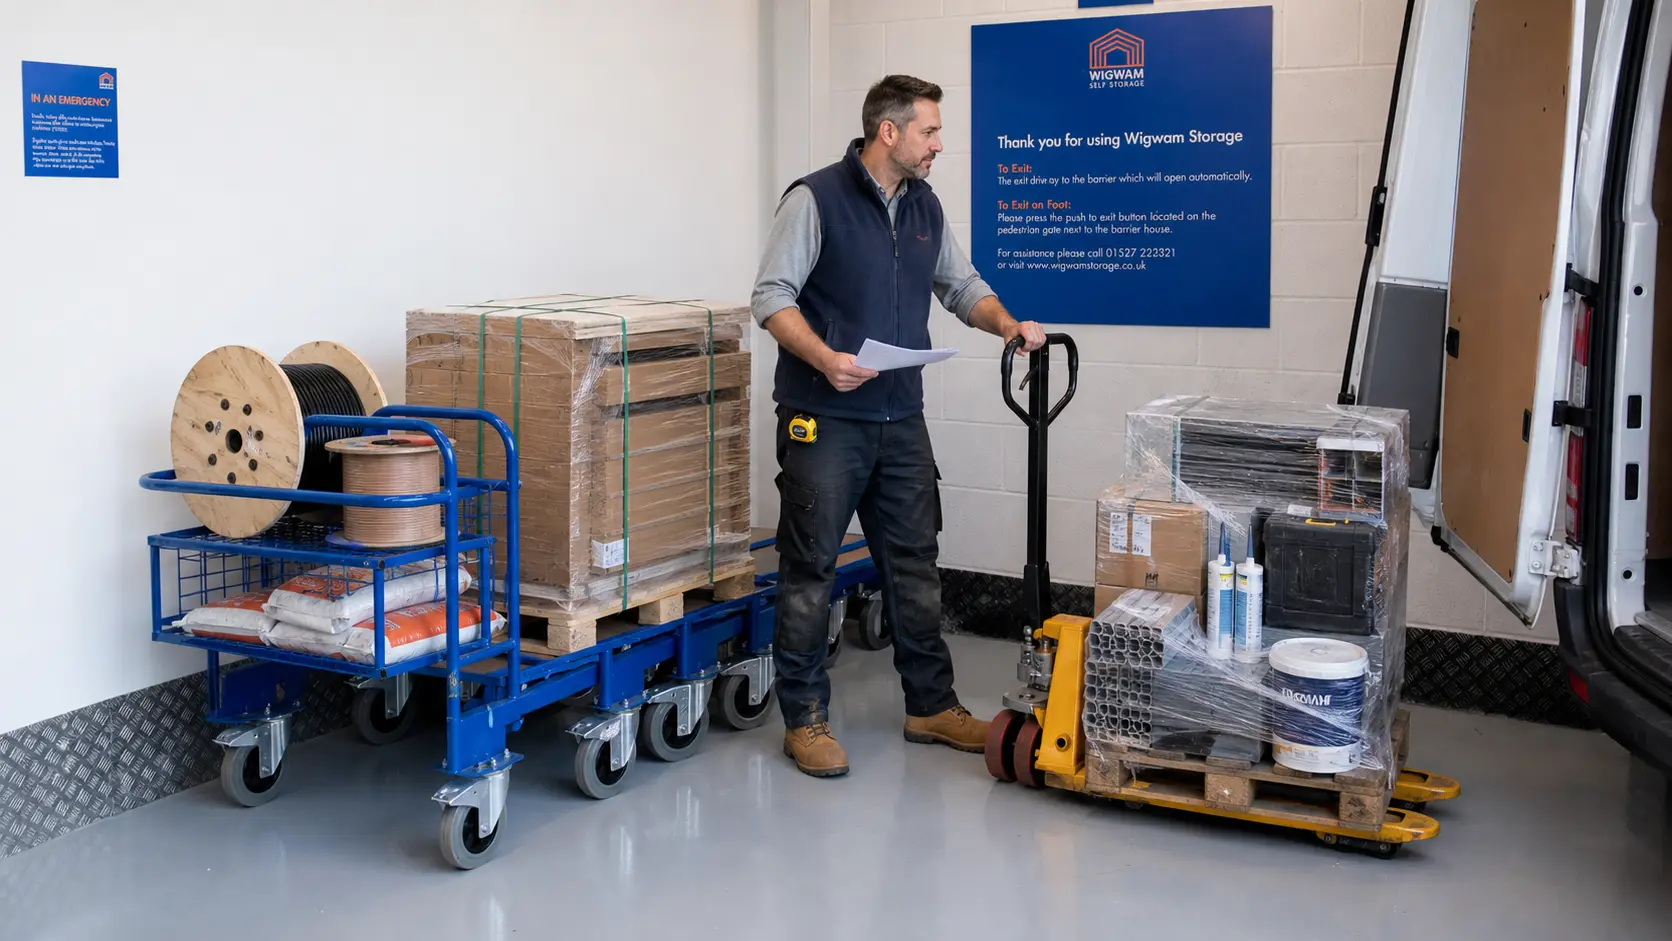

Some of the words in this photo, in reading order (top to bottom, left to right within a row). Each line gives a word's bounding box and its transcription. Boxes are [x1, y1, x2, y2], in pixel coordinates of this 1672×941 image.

[1089, 68, 1144, 81] WIGWAM
[1109, 80, 1145, 88] STORAGE
[31, 93, 41, 103] IN
[43, 94, 57, 104] AN
[58, 95, 111, 107] EMERGENCY
[997, 134, 1035, 149] Thank
[1038, 138, 1062, 151] you
[1065, 132, 1083, 147] for
[1087, 132, 1121, 149] using
[1124, 131, 1185, 148] Wigwam
[1189, 129, 1244, 146] Storage
[997, 163, 1009, 174] To
[1011, 163, 1033, 174] Exit:
[997, 176, 1012, 186] The
[1013, 176, 1028, 185] exit
[1062, 176, 1070, 184] to
[1072, 174, 1085, 184] the
[1087, 173, 1116, 184] barrier
[1119, 172, 1144, 183] which
[1146, 171, 1162, 182] will
[1164, 173, 1187, 185] open
[1189, 170, 1253, 183] automatically.
[997, 200, 1009, 210] To
[1011, 200, 1029, 210] Exit
[1031, 202, 1044, 210] on
[1047, 199, 1071, 210] Foot:
[997, 212, 1023, 223] Please
[1025, 214, 1048, 224] press
[1050, 212, 1063, 222] the
[1065, 212, 1086, 224] push
[1088, 213, 1098, 222] to
[1099, 212, 1116, 221] exit
[1118, 211, 1147, 221] button
[1150, 210, 1184, 221] located
[1186, 212, 1199, 221] on
[1201, 210, 1217, 221] the
[997, 224, 1040, 236] pedestrian
[1042, 226, 1061, 236] gate
[1063, 225, 1082, 234] next
[1084, 225, 1093, 234] to
[1095, 223, 1108, 234] the
[1111, 223, 1141, 234] barrier
[1143, 223, 1173, 234] house.
[997, 247, 1011, 257] For
[1013, 248, 1055, 258] assistance
[1057, 247, 1085, 260] please
[1087, 247, 1103, 258] call
[1106, 247, 1137, 258] 01527
[1140, 247, 1176, 258] 222321
[1008, 260, 1025, 270] visit
[1026, 259, 1147, 272] www.wigwamstorage.co.uk
